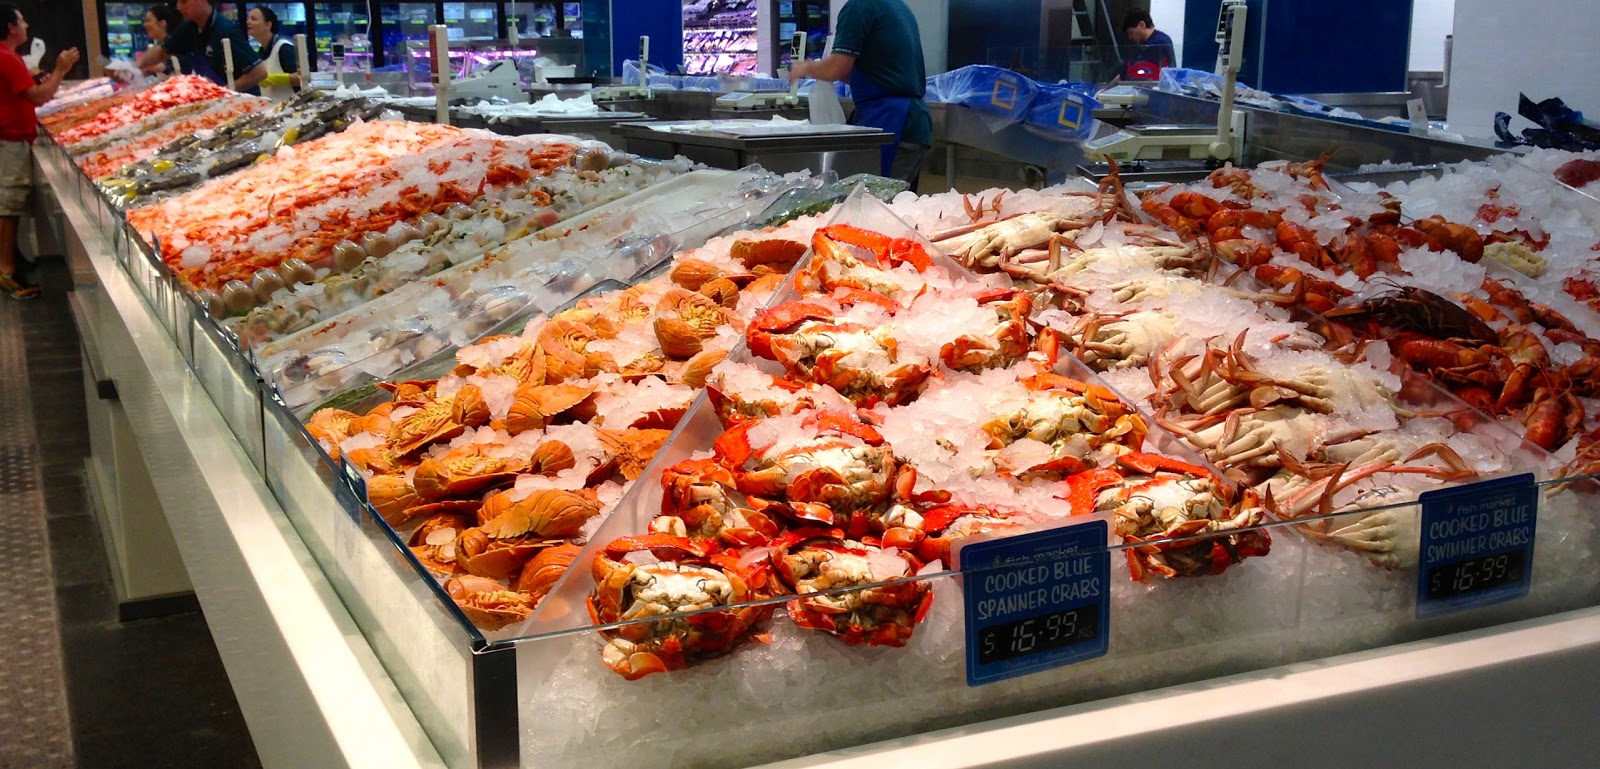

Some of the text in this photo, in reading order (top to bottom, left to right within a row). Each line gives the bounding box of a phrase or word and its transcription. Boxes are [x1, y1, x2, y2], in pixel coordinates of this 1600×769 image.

[1429, 505, 1529, 539] COOKED BLUE
[1427, 526, 1529, 563] SWIMMER CRABS
[985, 556, 1092, 594] COOKED BLUE
[1453, 555, 1508, 591] 16.99
[977, 577, 1100, 621] SPANNER CRABS
[983, 632, 995, 656] $
[1011, 611, 1078, 652] 16.99
